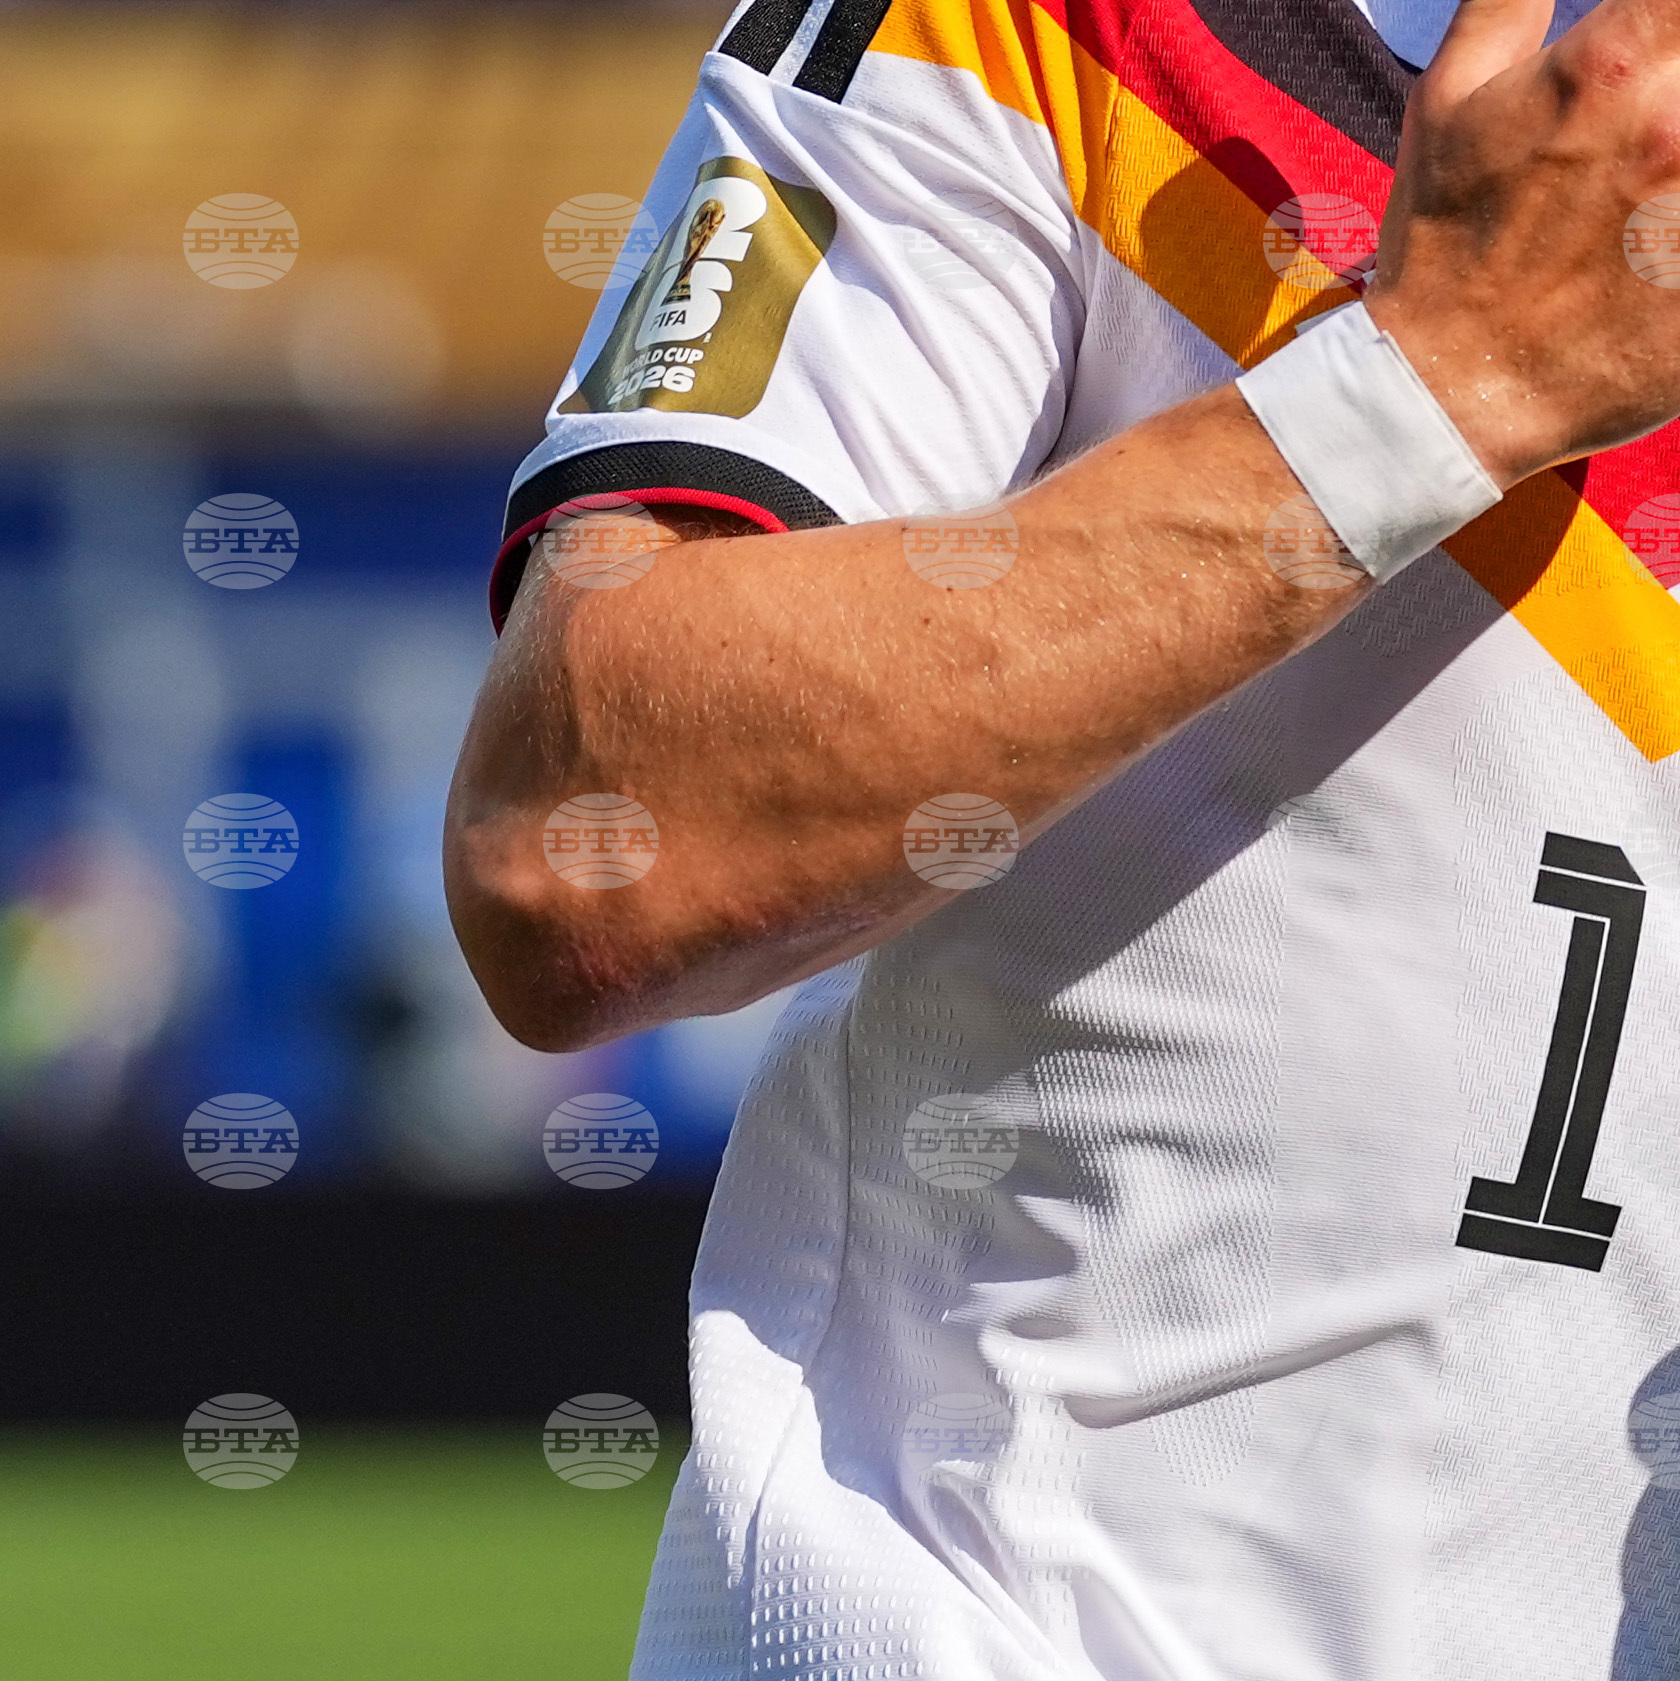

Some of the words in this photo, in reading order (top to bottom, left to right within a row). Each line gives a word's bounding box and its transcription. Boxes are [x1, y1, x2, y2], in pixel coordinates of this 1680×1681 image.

[650, 310, 687, 332] FIFA
[663, 347, 705, 364] CUP
[607, 365, 696, 405] 2026
